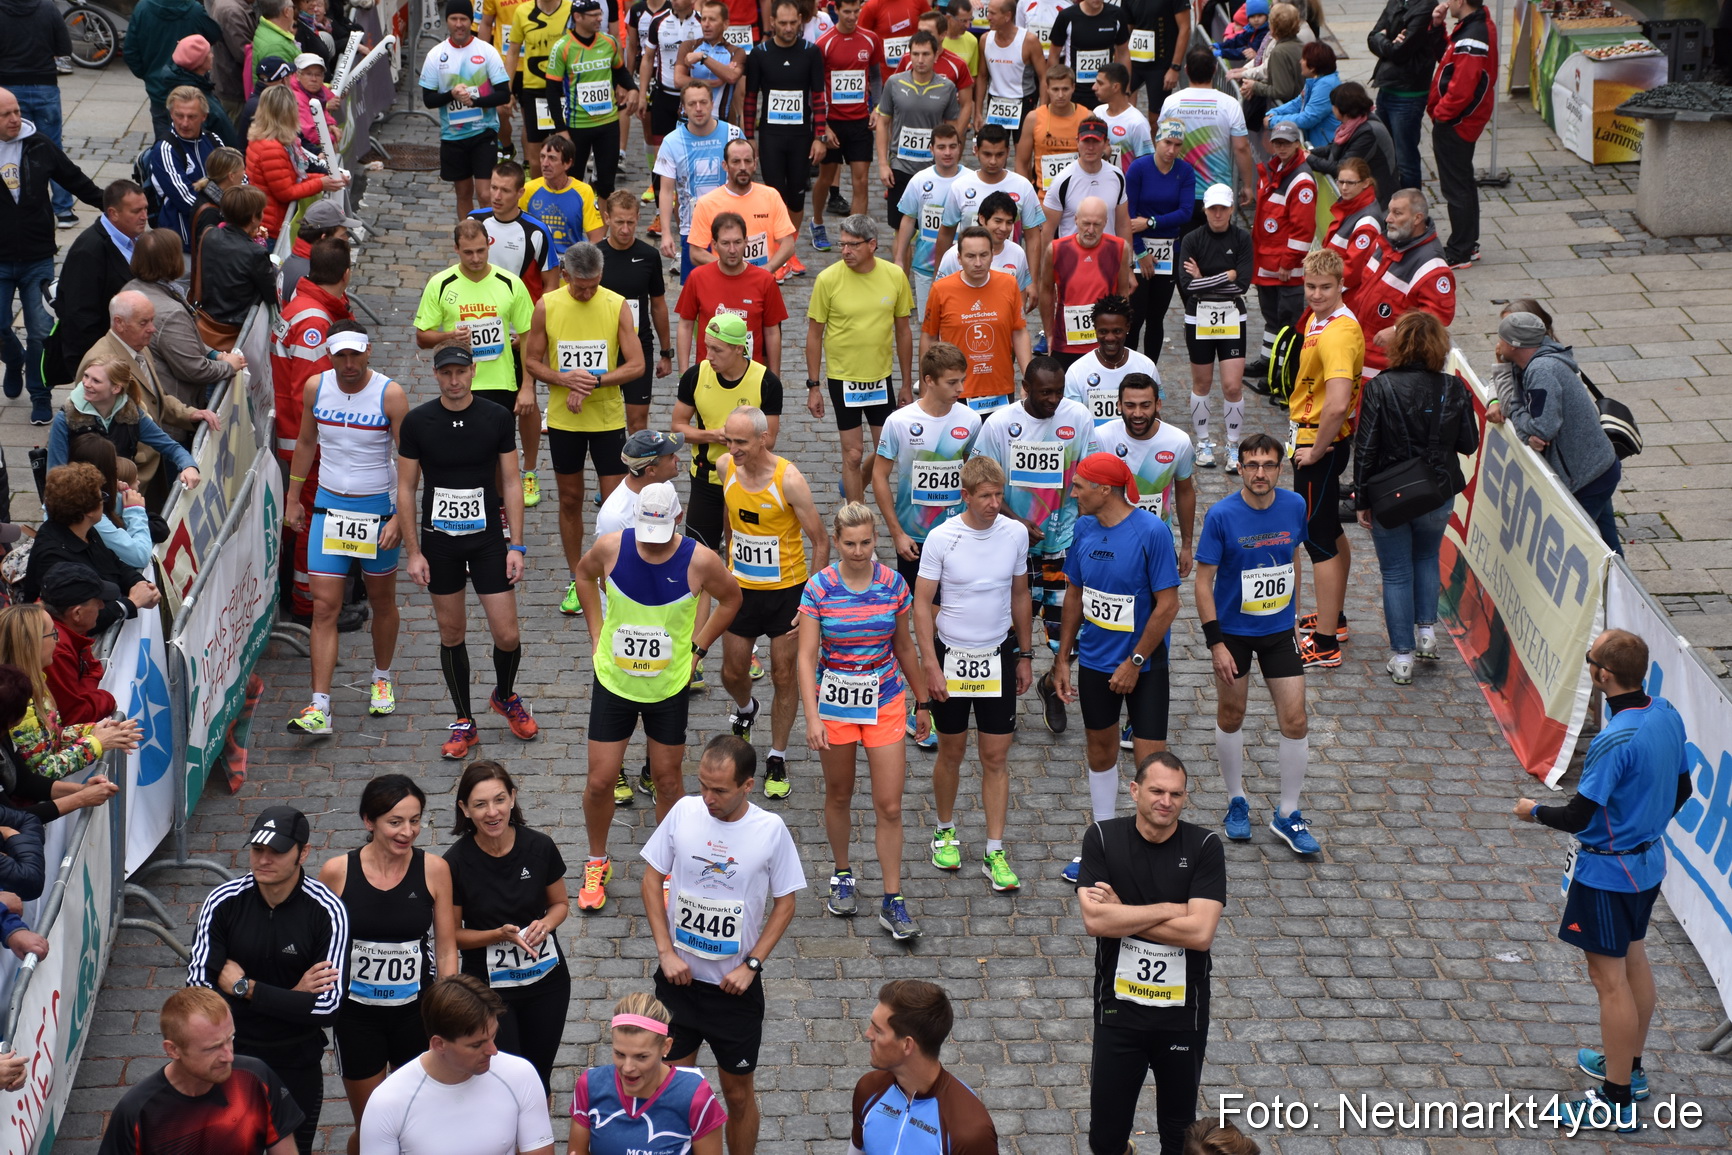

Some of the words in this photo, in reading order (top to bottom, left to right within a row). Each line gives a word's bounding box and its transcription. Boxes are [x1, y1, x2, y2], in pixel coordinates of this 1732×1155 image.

[724, 32, 750, 44] 2335
[1132, 38, 1148, 50] 504
[888, 44, 908, 57] 267
[571, 57, 612, 74] BOCK
[835, 78, 863, 91] 2762
[582, 88, 609, 103] 2809
[772, 98, 800, 112] 2720
[991, 104, 1019, 118] 2552
[1177, 108, 1218, 116] NeuerMarkt
[690, 139, 722, 147] VIERTL
[902, 135, 932, 149] 2617
[925, 215, 940, 230] 30
[743, 241, 765, 259] 087
[458, 303, 497, 314] Müller
[961, 311, 998, 320] SportScheck
[472, 321, 495, 329] Neumarkt
[1073, 314, 1091, 330] 18
[1210, 311, 1226, 326] 31
[469, 327, 501, 346] 502
[973, 324, 987, 340] 5.
[1210, 327, 1226, 335] Anita
[562, 351, 603, 368] 2137
[1015, 452, 1060, 471] 3085
[917, 471, 960, 489] 2648
[452, 492, 477, 500] Neumarkt
[927, 492, 949, 500] Niklas
[438, 500, 480, 519] 2533
[336, 521, 368, 541] 145
[443, 520, 475, 530] Christian
[745, 538, 770, 546] Neumarkt
[1237, 531, 1280, 544] SYNERGY
[341, 541, 359, 552] Toby
[735, 543, 773, 565] 3011
[1262, 570, 1288, 578] Neumarkt
[1254, 577, 1286, 599] 206
[1099, 595, 1124, 603] Neumarkt
[1262, 600, 1277, 610] Karl
[1091, 600, 1123, 622] 537
[1467, 520, 1562, 697] PFLASTERSTEINE
[624, 637, 661, 658] 378
[632, 661, 650, 670] Andi
[956, 659, 991, 679] 383
[825, 673, 842, 685] PARTL
[842, 679, 870, 687] Neumarkt
[959, 682, 986, 693] Jürgen
[825, 684, 874, 706] 3016
[677, 894, 697, 909] PARTL
[697, 903, 731, 914] Neumarkt
[680, 907, 736, 938] 2446
[353, 945, 376, 955] PARTL
[377, 948, 412, 956] Neumarkt
[687, 935, 722, 953] Michael
[1121, 941, 1142, 955] PARTL
[1143, 948, 1178, 958] Neumarkt
[356, 955, 417, 982] 2703
[508, 968, 542, 980] Sandra
[1136, 957, 1168, 984] 32
[373, 987, 395, 999] Inge
[1128, 983, 1172, 1000] Wolfgang
